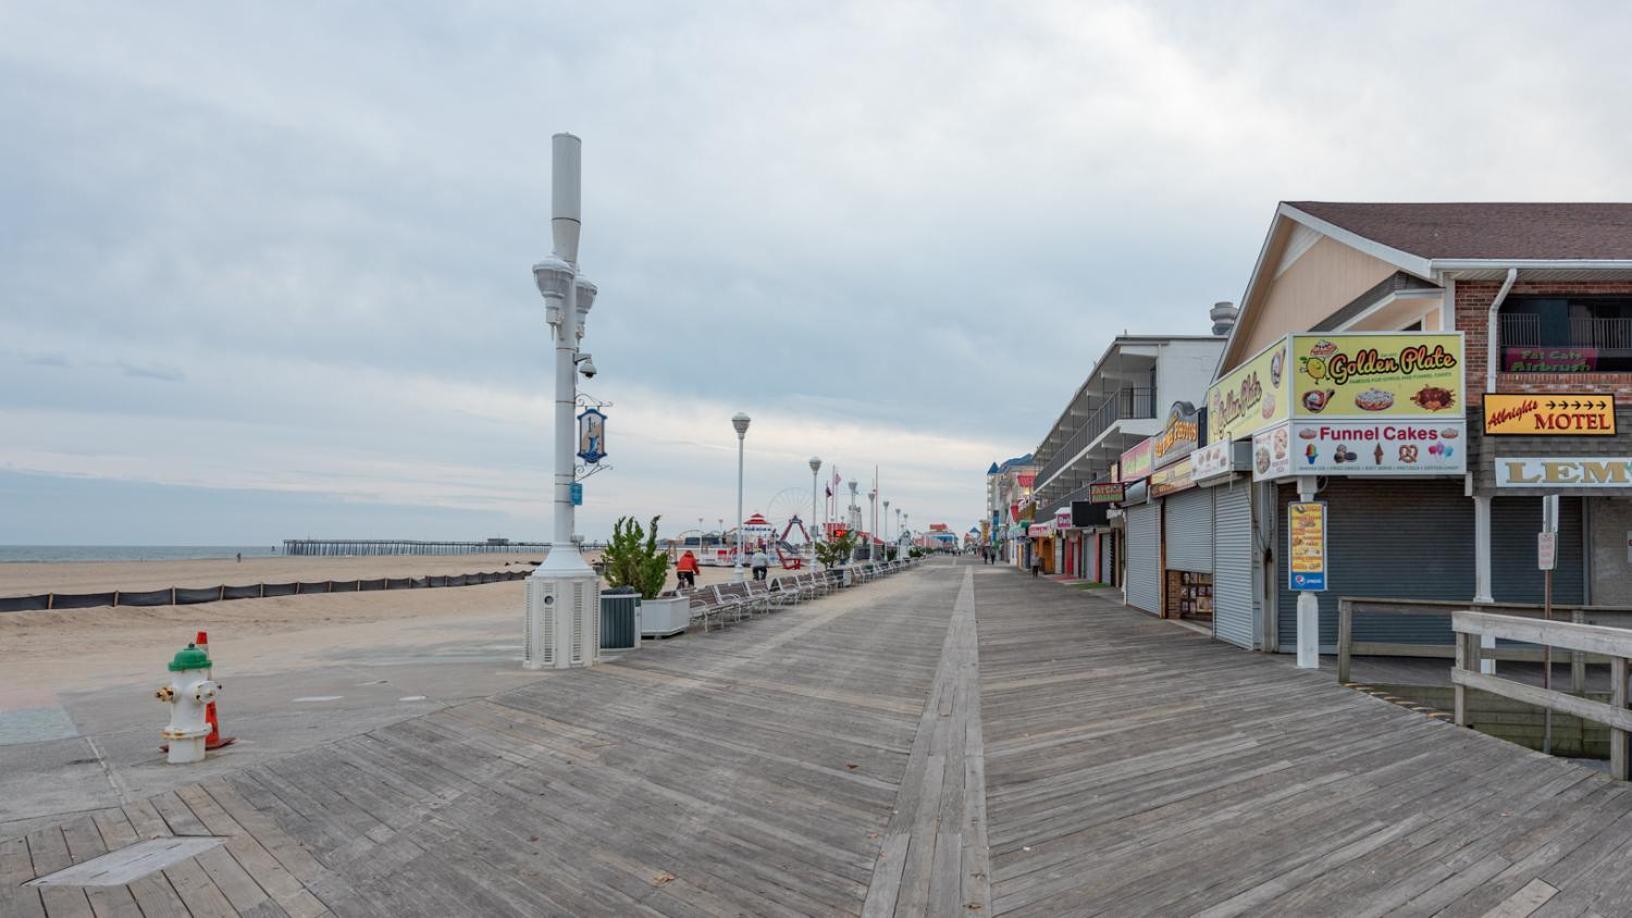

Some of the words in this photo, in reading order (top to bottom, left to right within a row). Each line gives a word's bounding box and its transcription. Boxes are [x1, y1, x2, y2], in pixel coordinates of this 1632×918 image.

[1328, 349, 1399, 385] Golden
[1400, 344, 1457, 374] Plate
[1534, 413, 1611, 430] MOTEL
[1320, 426, 1379, 441] Funnel
[1383, 427, 1438, 441] Cakes
